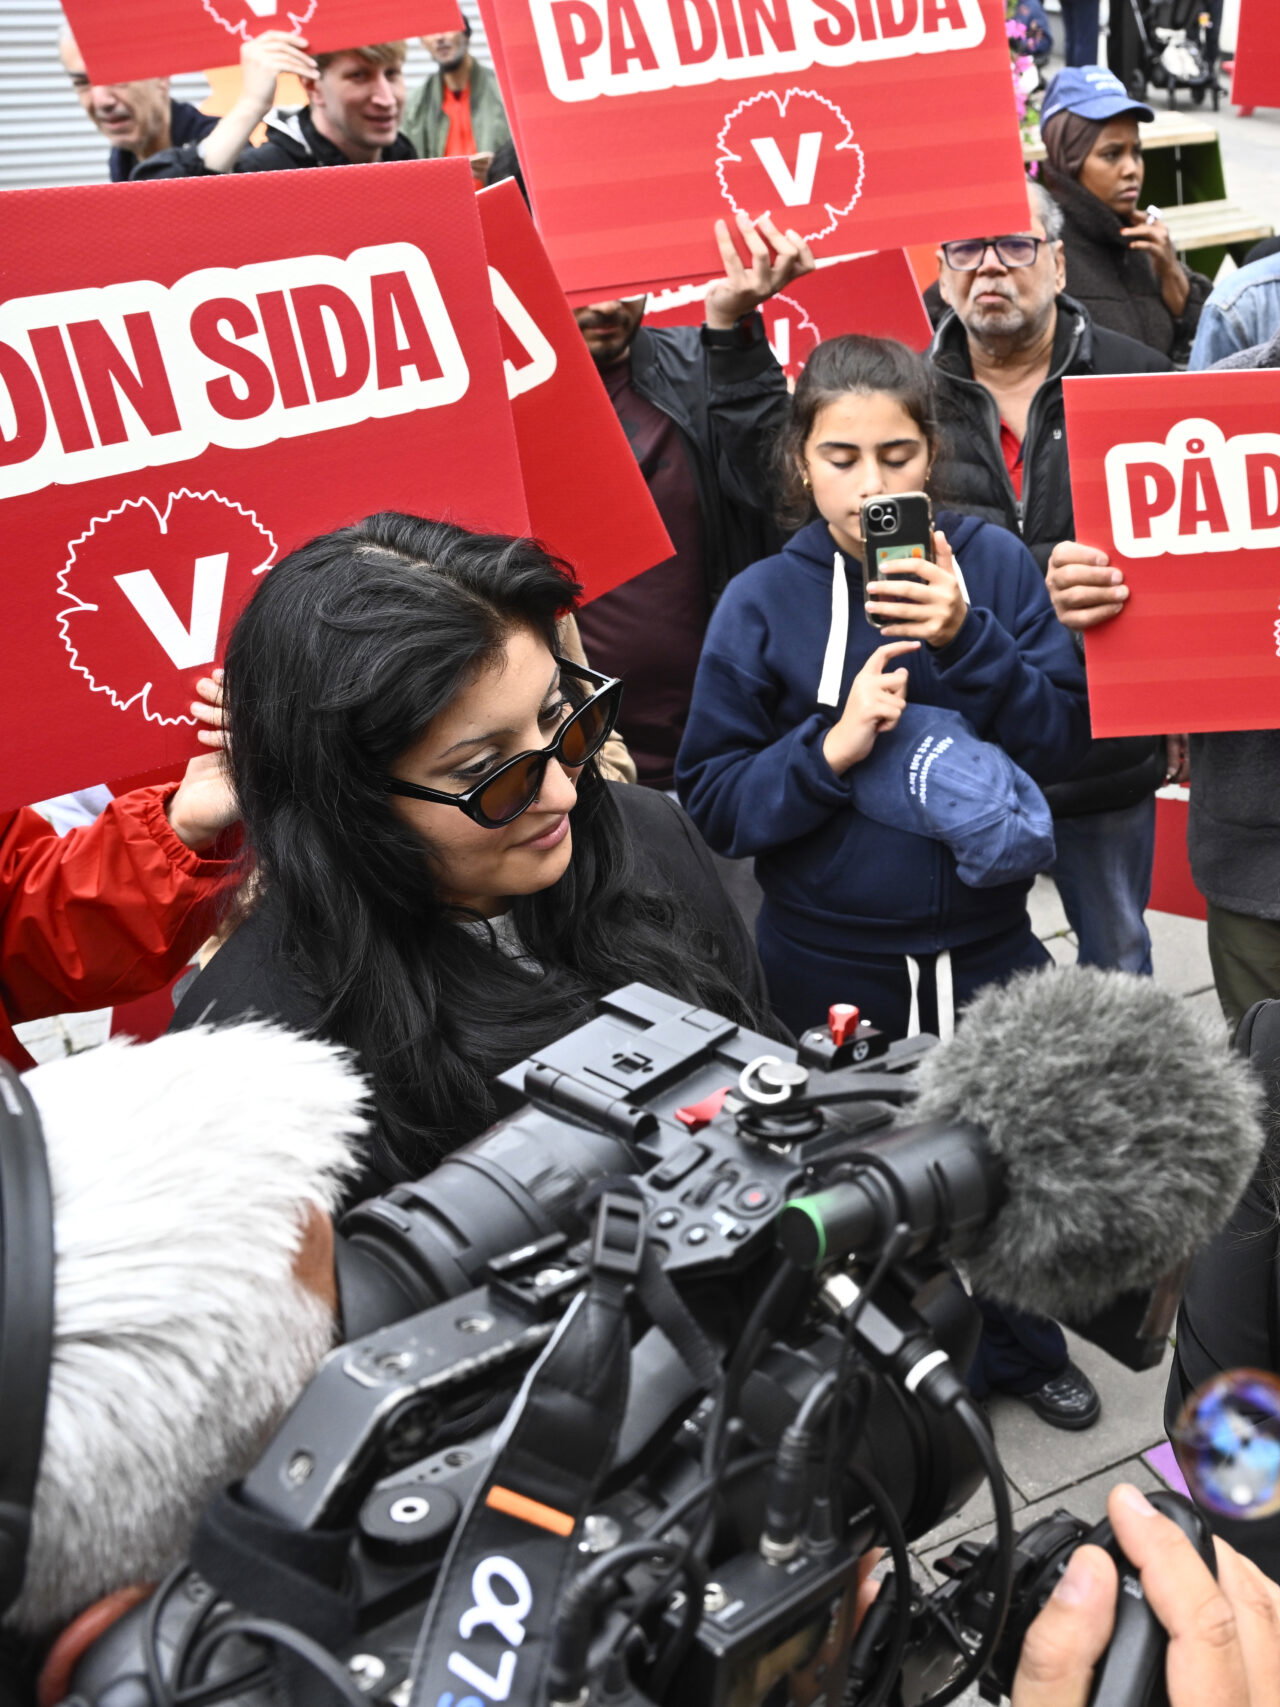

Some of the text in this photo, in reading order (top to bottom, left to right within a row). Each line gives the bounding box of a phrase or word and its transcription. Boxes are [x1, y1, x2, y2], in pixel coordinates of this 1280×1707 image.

[667, 0, 797, 66] DIN
[750, 132, 823, 208] V
[190, 270, 445, 421] SIDA
[1126, 438, 1230, 539] PÅ
[113, 552, 230, 670] V
